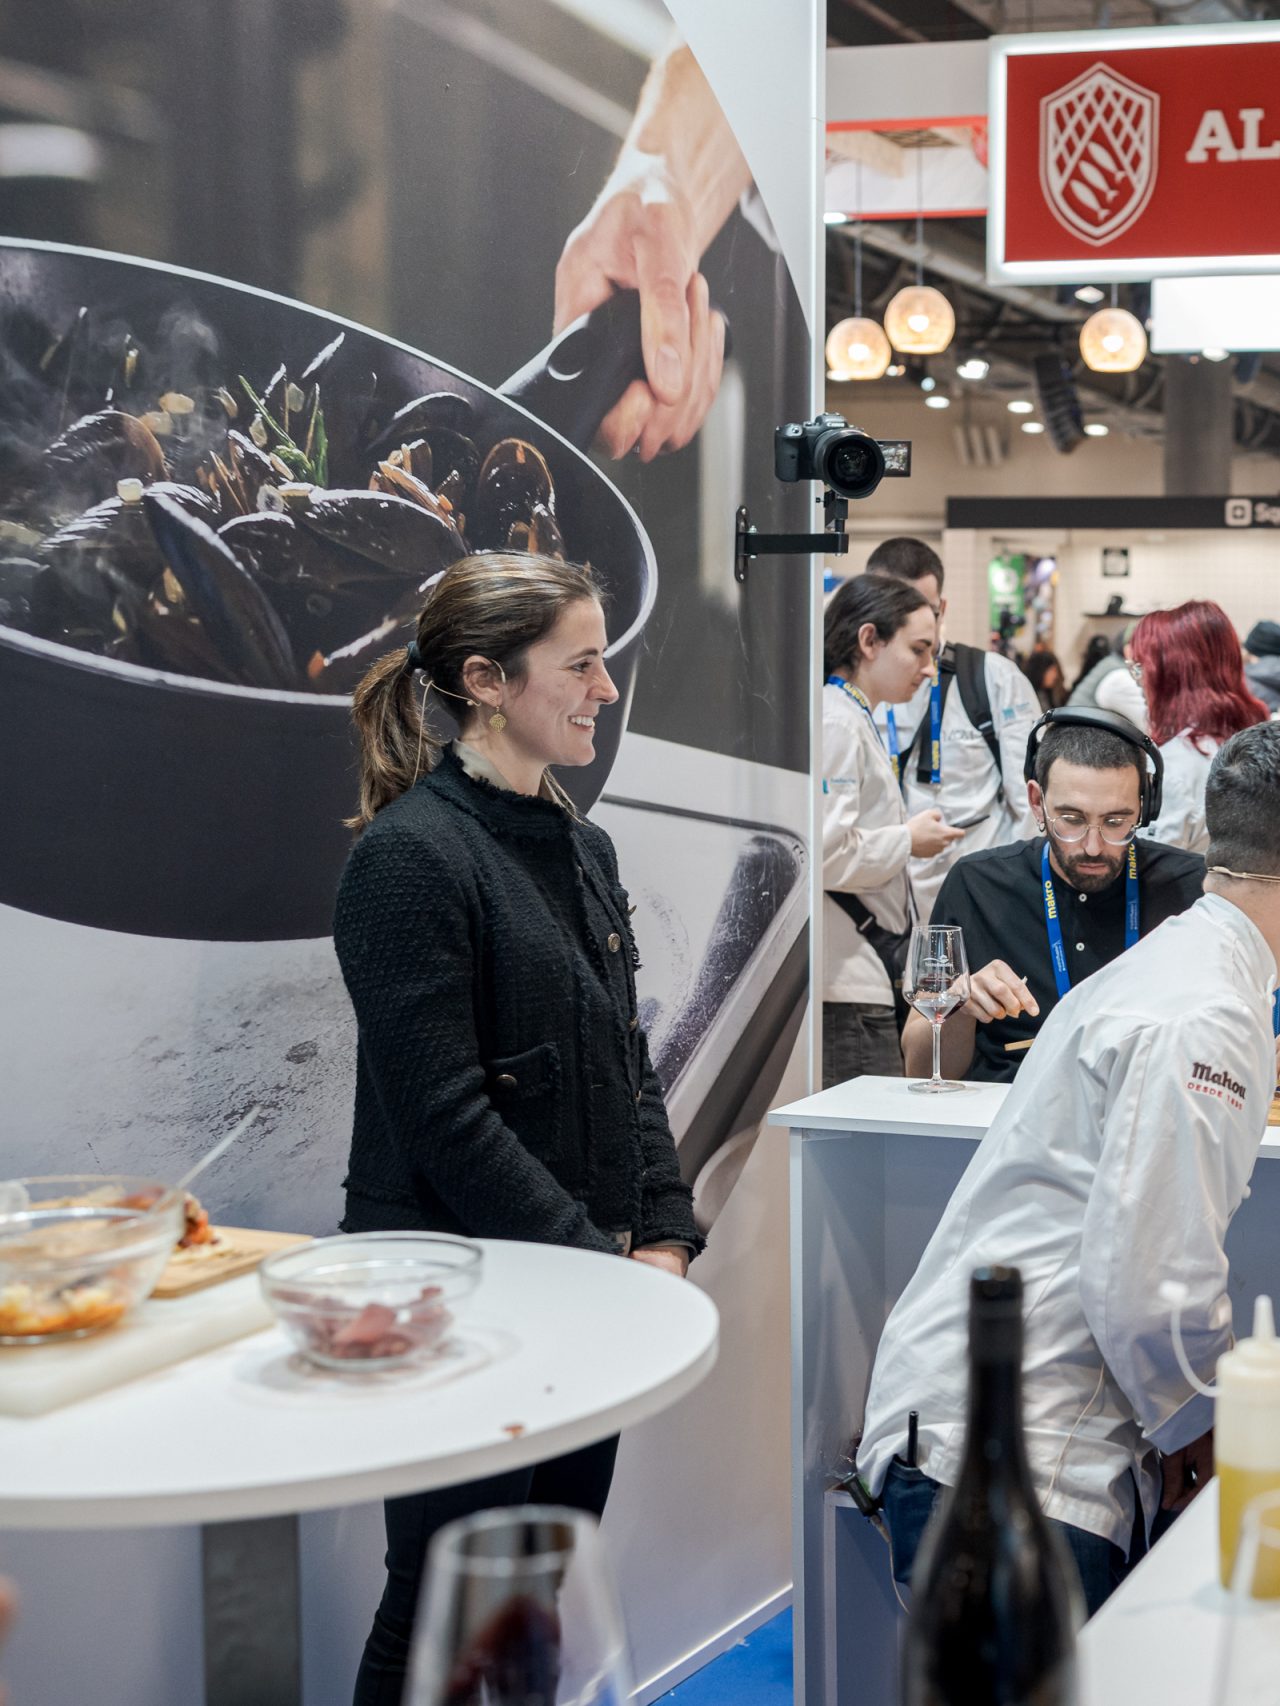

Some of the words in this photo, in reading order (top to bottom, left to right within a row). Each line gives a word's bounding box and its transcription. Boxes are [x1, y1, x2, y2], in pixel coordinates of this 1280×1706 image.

[1044, 880, 1057, 919] makro
[1187, 1082, 1223, 1098] DESDE
[1192, 1062, 1246, 1099] Mahou
